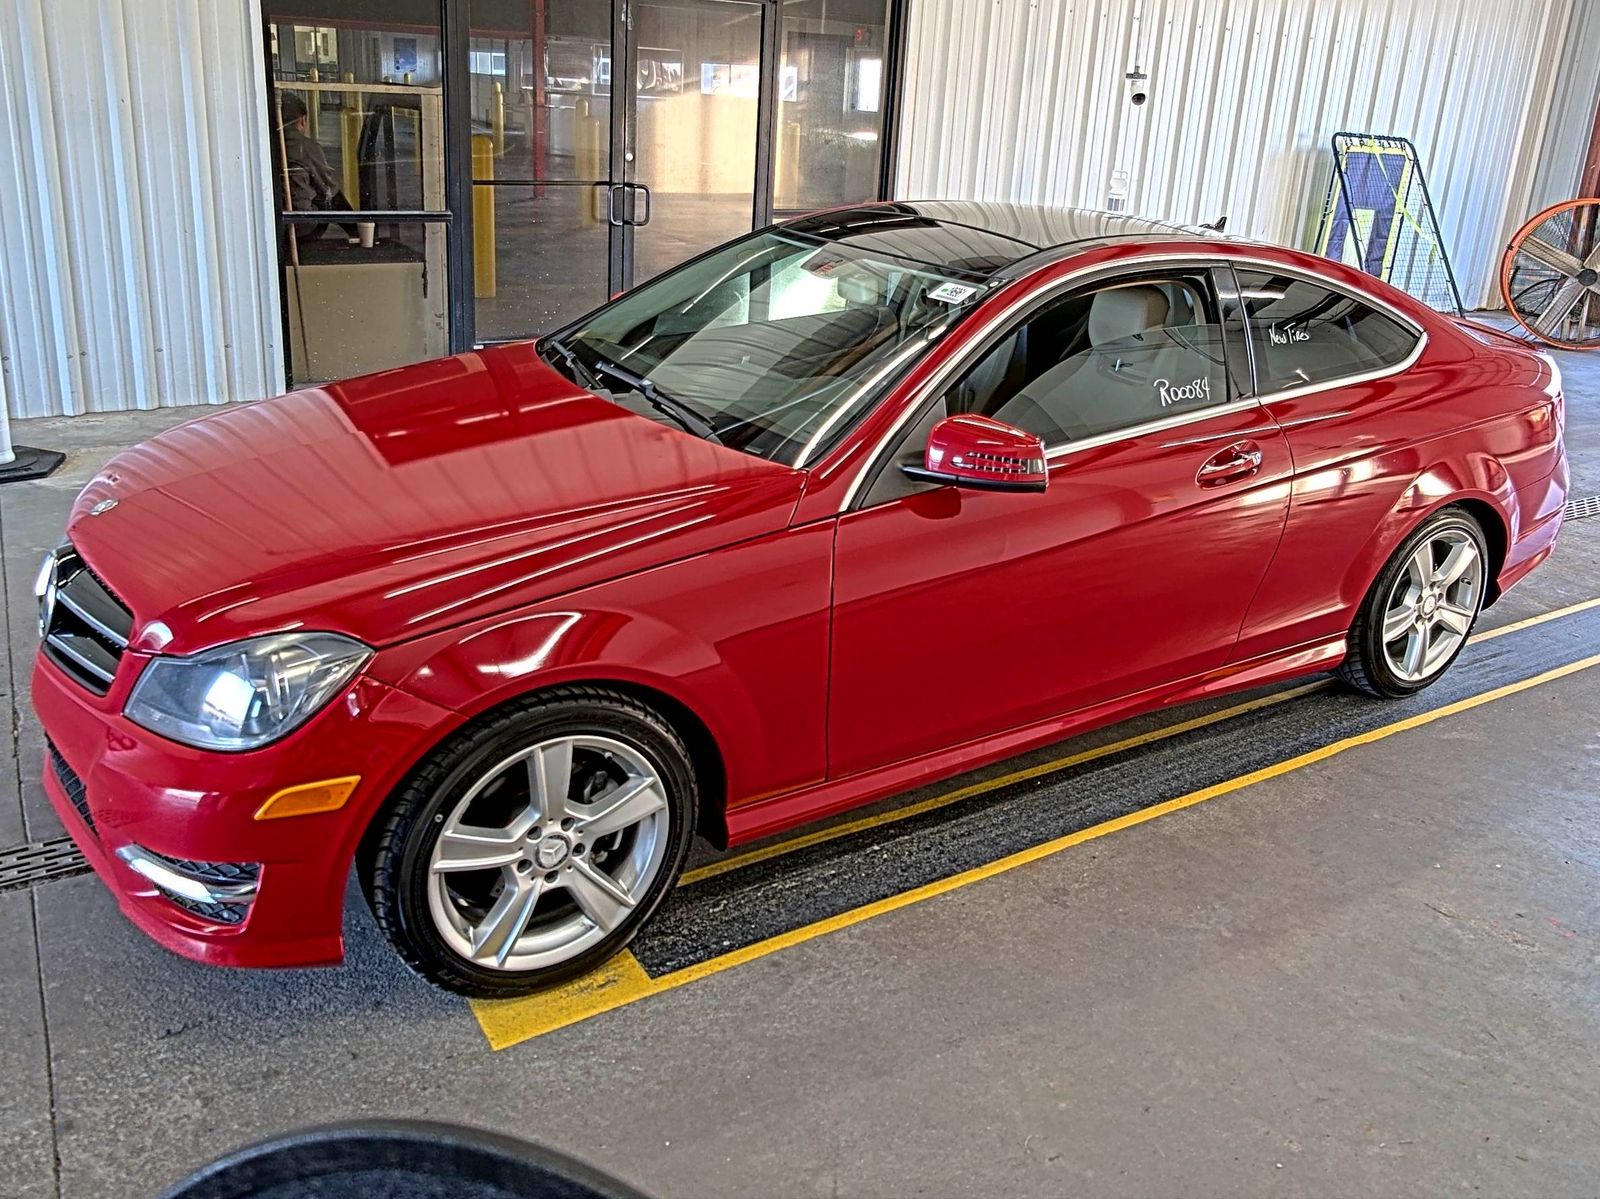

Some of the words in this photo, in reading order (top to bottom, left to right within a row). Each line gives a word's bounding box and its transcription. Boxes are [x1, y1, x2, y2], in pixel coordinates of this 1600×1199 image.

[1268, 322, 1287, 347] New
[1283, 322, 1310, 344] Tires
[1153, 376, 1211, 407] R00084
